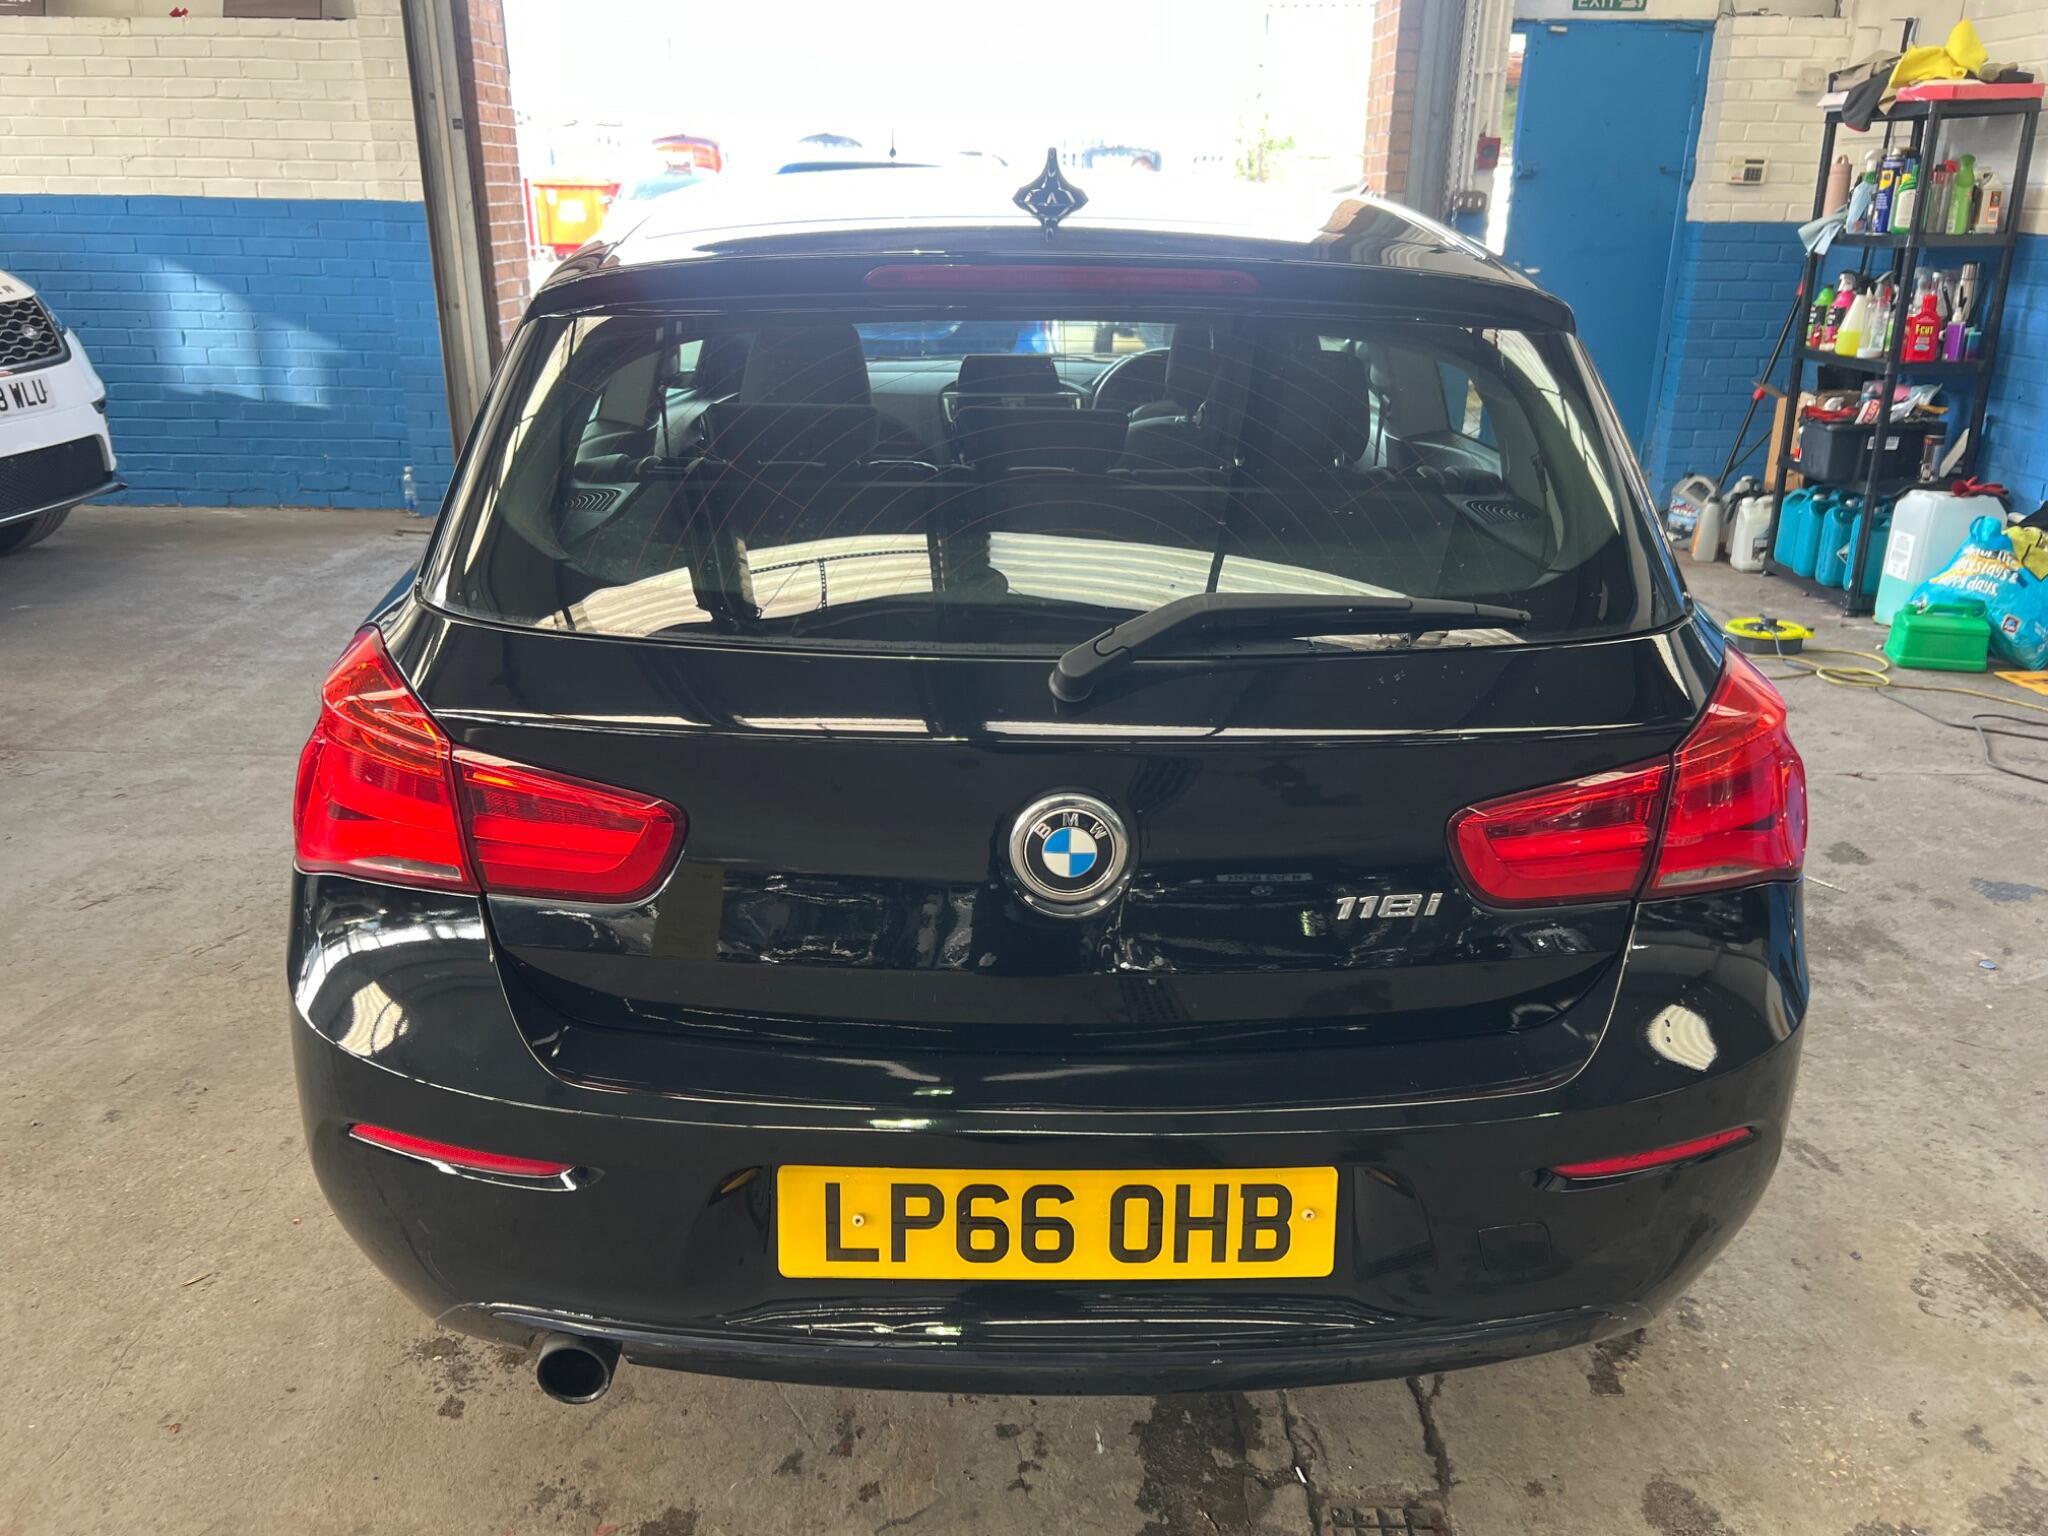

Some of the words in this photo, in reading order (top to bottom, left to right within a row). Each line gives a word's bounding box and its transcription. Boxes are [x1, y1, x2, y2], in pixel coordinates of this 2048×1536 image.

[1578, 0, 1615, 8] EXIT
[8, 379, 47, 408] WLU
[1034, 813, 1108, 840] BMW
[1336, 892, 1443, 920] 118i
[825, 1182, 1075, 1264] LP66
[1109, 1183, 1293, 1263] OHB
